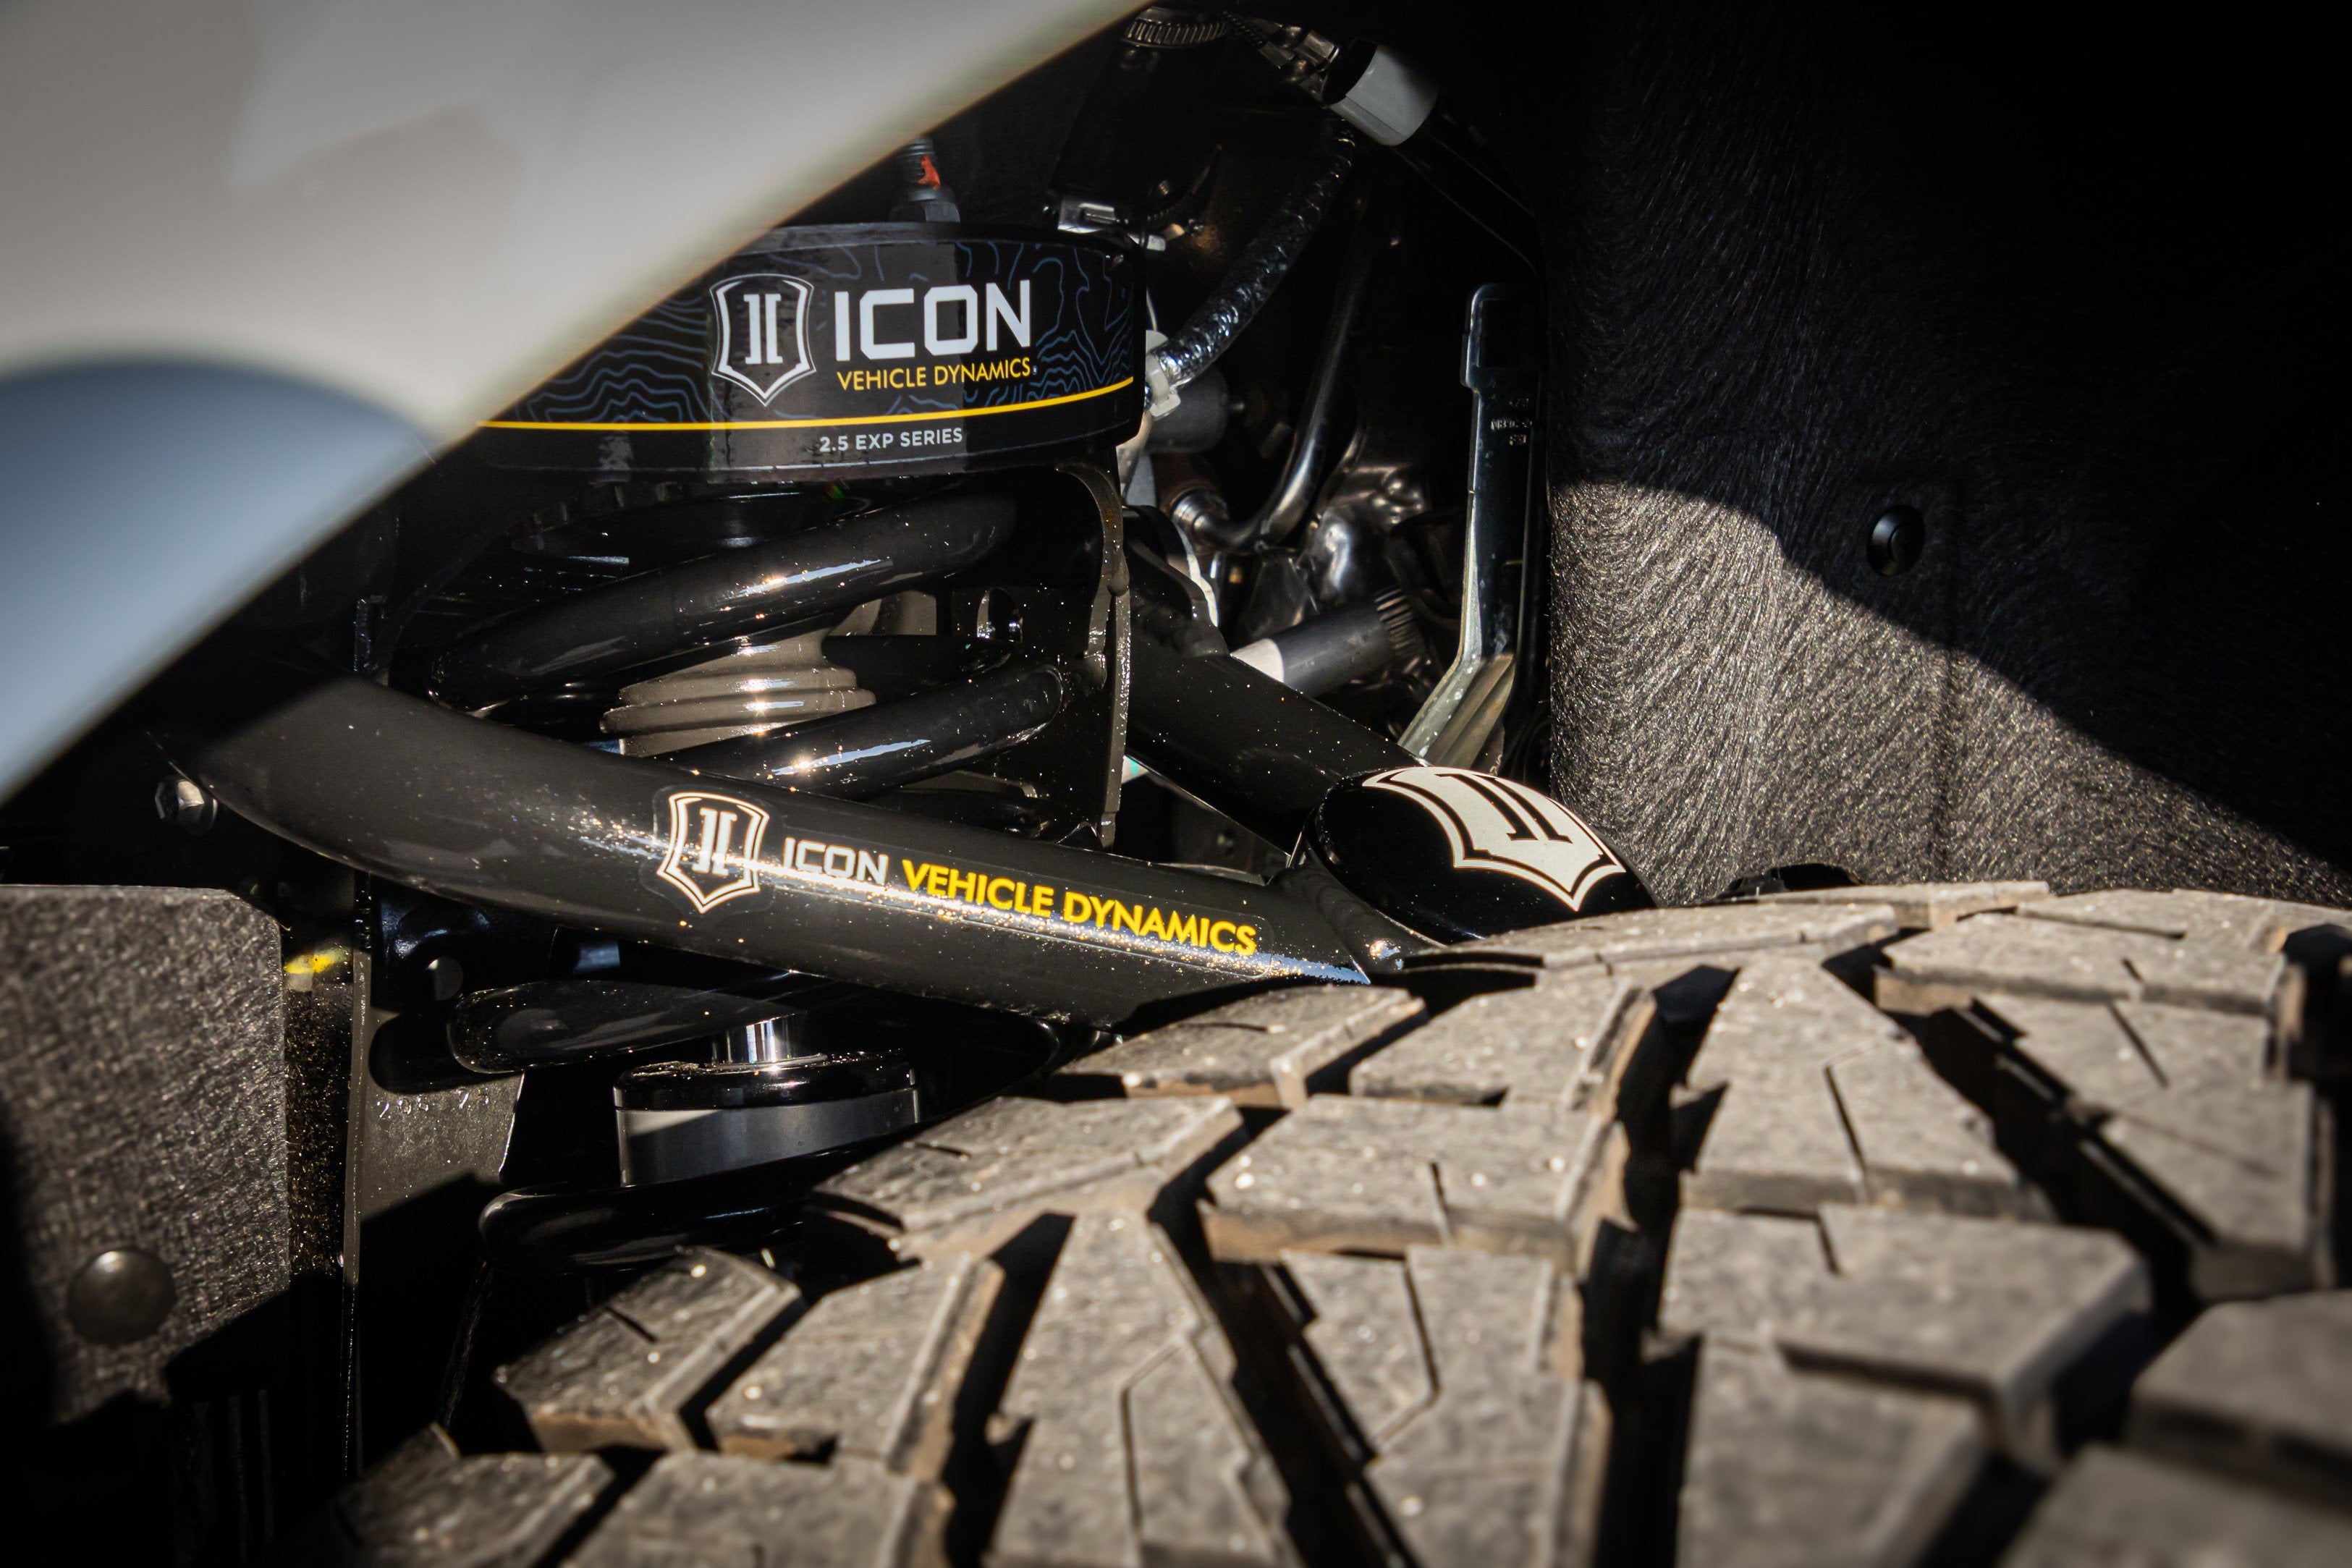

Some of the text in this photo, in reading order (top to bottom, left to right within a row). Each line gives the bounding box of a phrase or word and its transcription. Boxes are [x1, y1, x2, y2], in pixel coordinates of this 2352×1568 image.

[834, 279, 1031, 361] ICON
[837, 357, 1031, 391] VEHICLE DYNAMICS
[819, 427, 963, 452] 2.5 EXP SERIES
[783, 836, 1256, 957] ICON VEHICLE DYNAMICS
